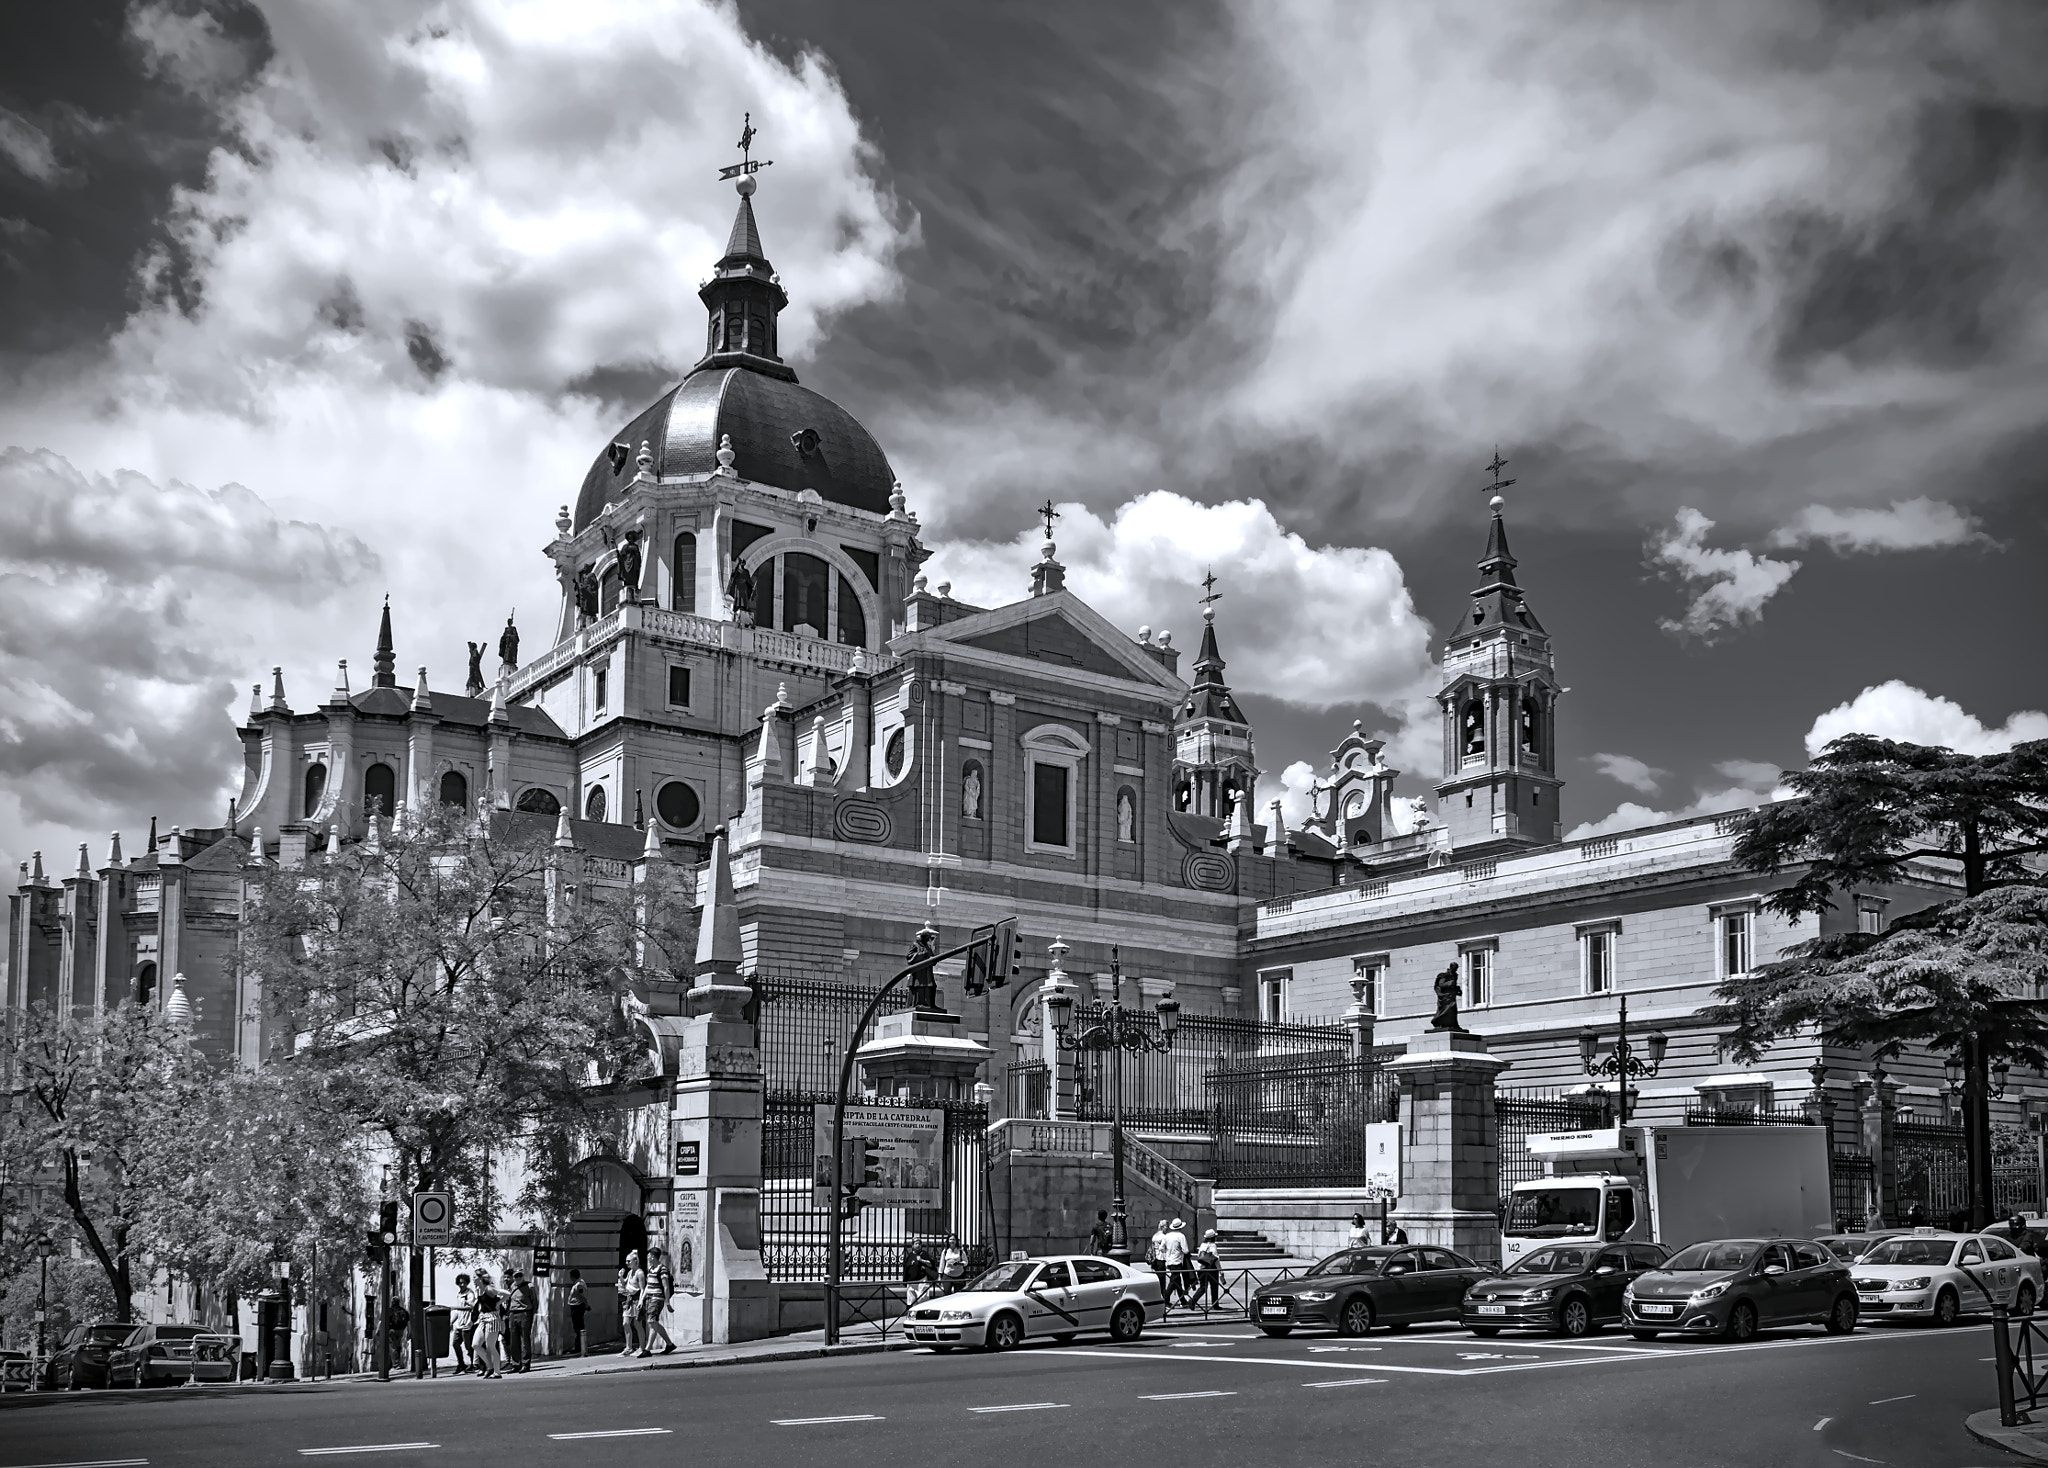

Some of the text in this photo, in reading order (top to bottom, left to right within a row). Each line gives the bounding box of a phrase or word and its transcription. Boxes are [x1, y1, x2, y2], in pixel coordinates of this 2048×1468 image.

[842, 1111, 931, 1122] RIPTA DE LA CATEDRAL
[680, 1145, 696, 1155] CRIPTA
[1507, 1243, 1520, 1252] 142
